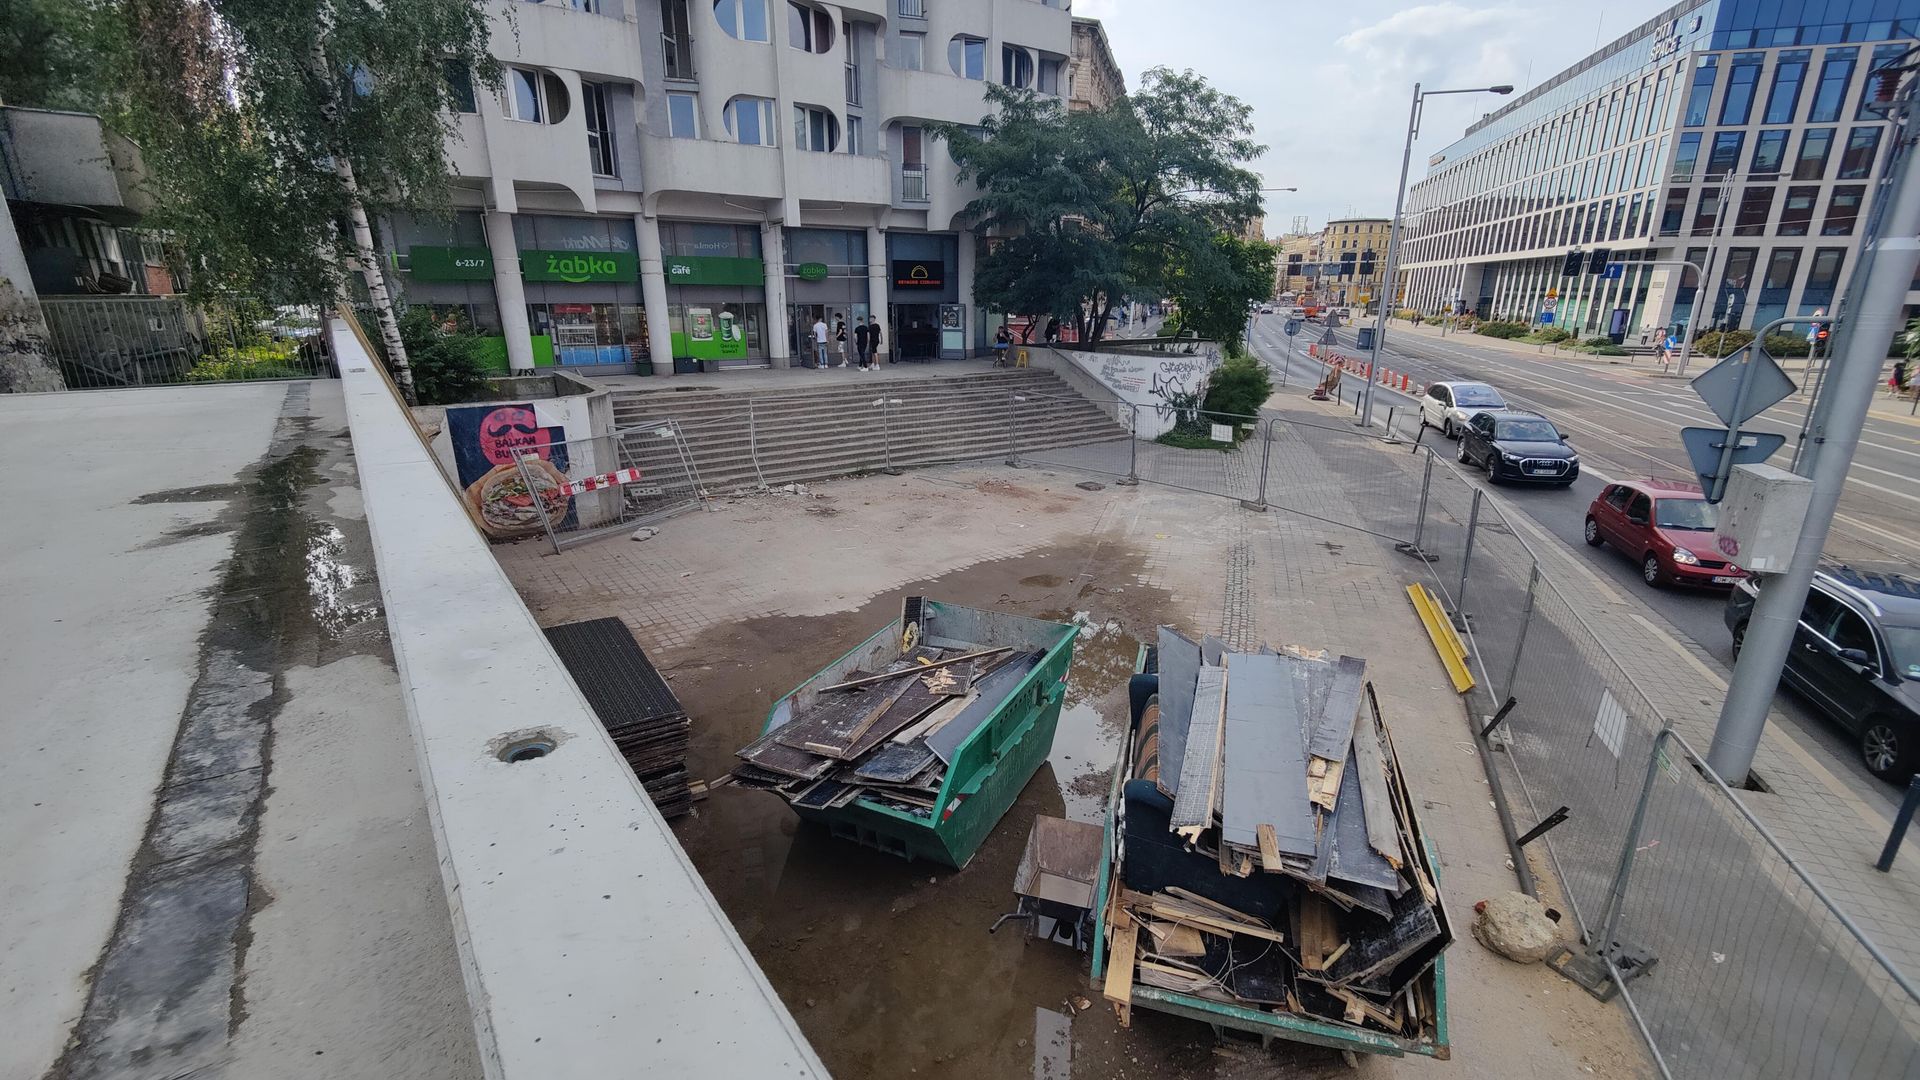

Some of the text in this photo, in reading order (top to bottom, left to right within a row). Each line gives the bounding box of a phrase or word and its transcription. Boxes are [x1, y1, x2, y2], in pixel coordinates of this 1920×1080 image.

[1654, 20, 1678, 43] CITY
[1650, 36, 1681, 62] SPACE
[455, 259, 485, 268] 6-23/7
[546, 254, 617, 275] żabka
[672, 266, 690, 275] café
[495, 436, 536, 448] BALKAN
